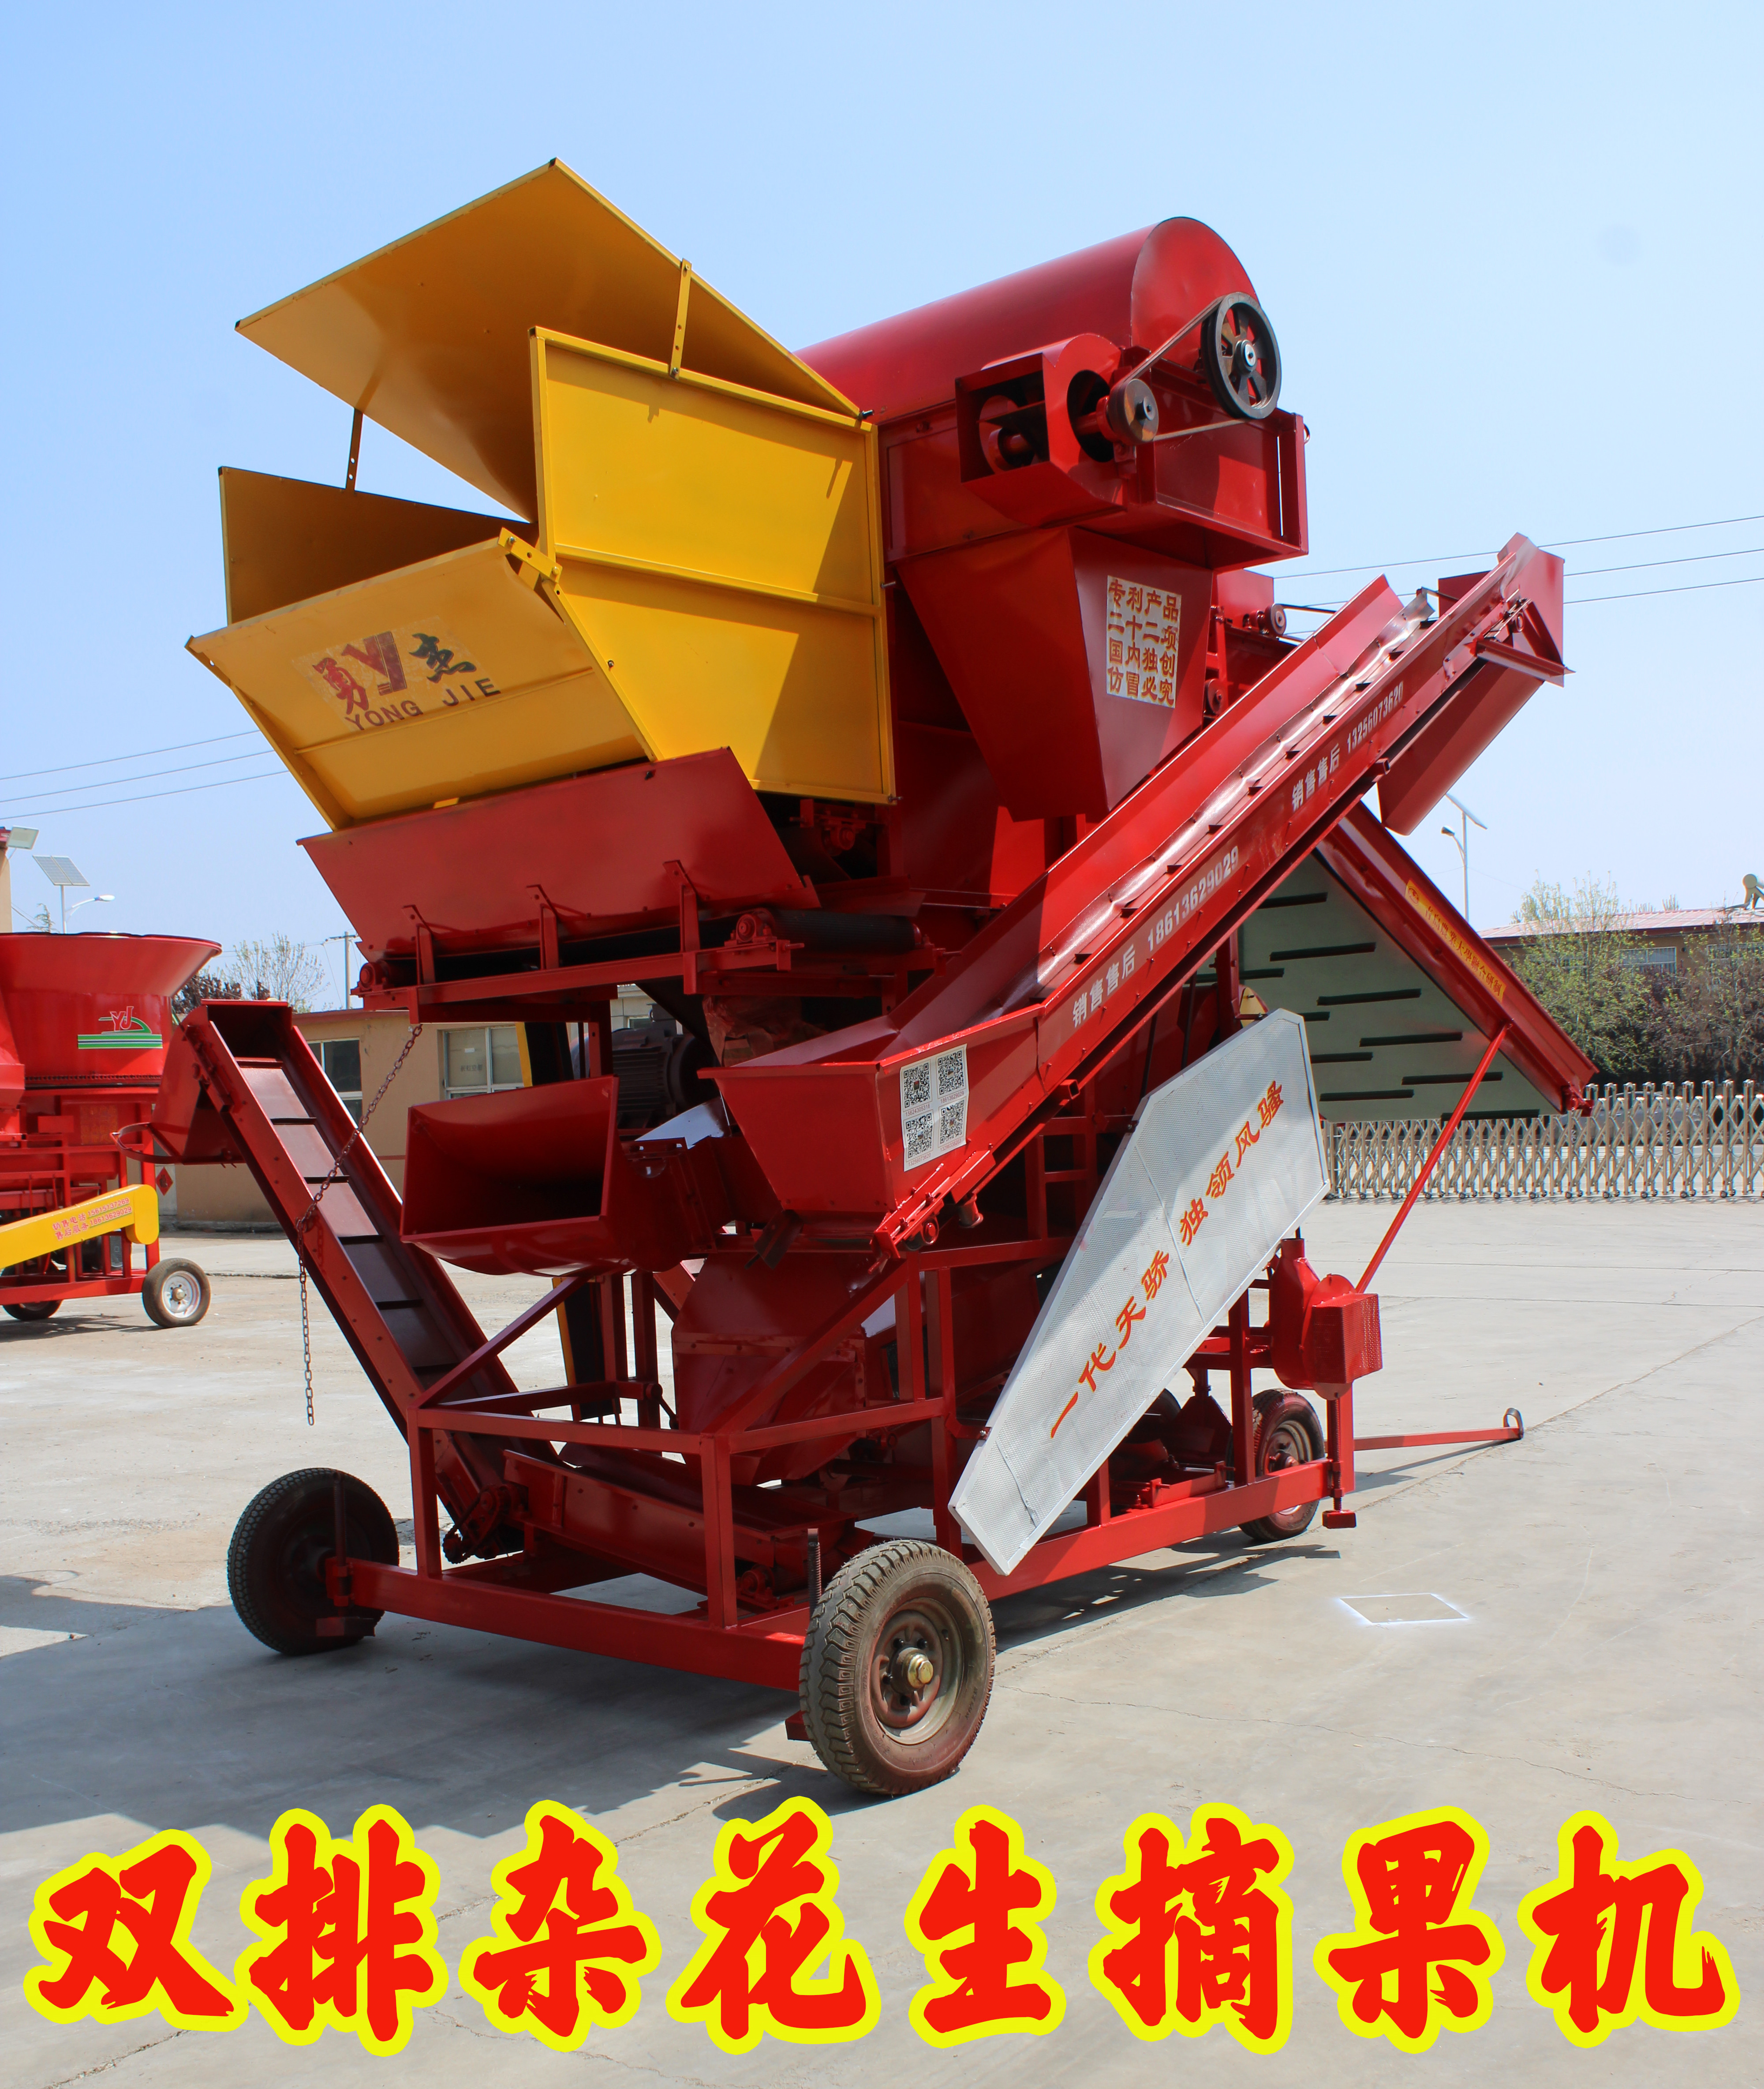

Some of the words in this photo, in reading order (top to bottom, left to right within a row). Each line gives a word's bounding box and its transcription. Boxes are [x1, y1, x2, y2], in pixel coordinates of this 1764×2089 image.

[1109, 580, 1178, 621] 专利产品
[1107, 611, 1178, 653] 二十二项
[1109, 638, 1175, 678] 国内独创
[345, 700, 423, 731] YONG
[442, 677, 501, 707] JIE
[1107, 666, 1174, 705] 仿冒必究
[1292, 743, 1340, 812] 销售售后
[1347, 681, 1404, 754] 13256073620
[1073, 945, 1135, 1028] 销售售后
[1147, 845, 1240, 952] 18613629029
[110, 1006, 134, 1031] YJ
[1050, 1250, 1170, 1438] 一代天骄
[1180, 1080, 1283, 1245] 独领风骚
